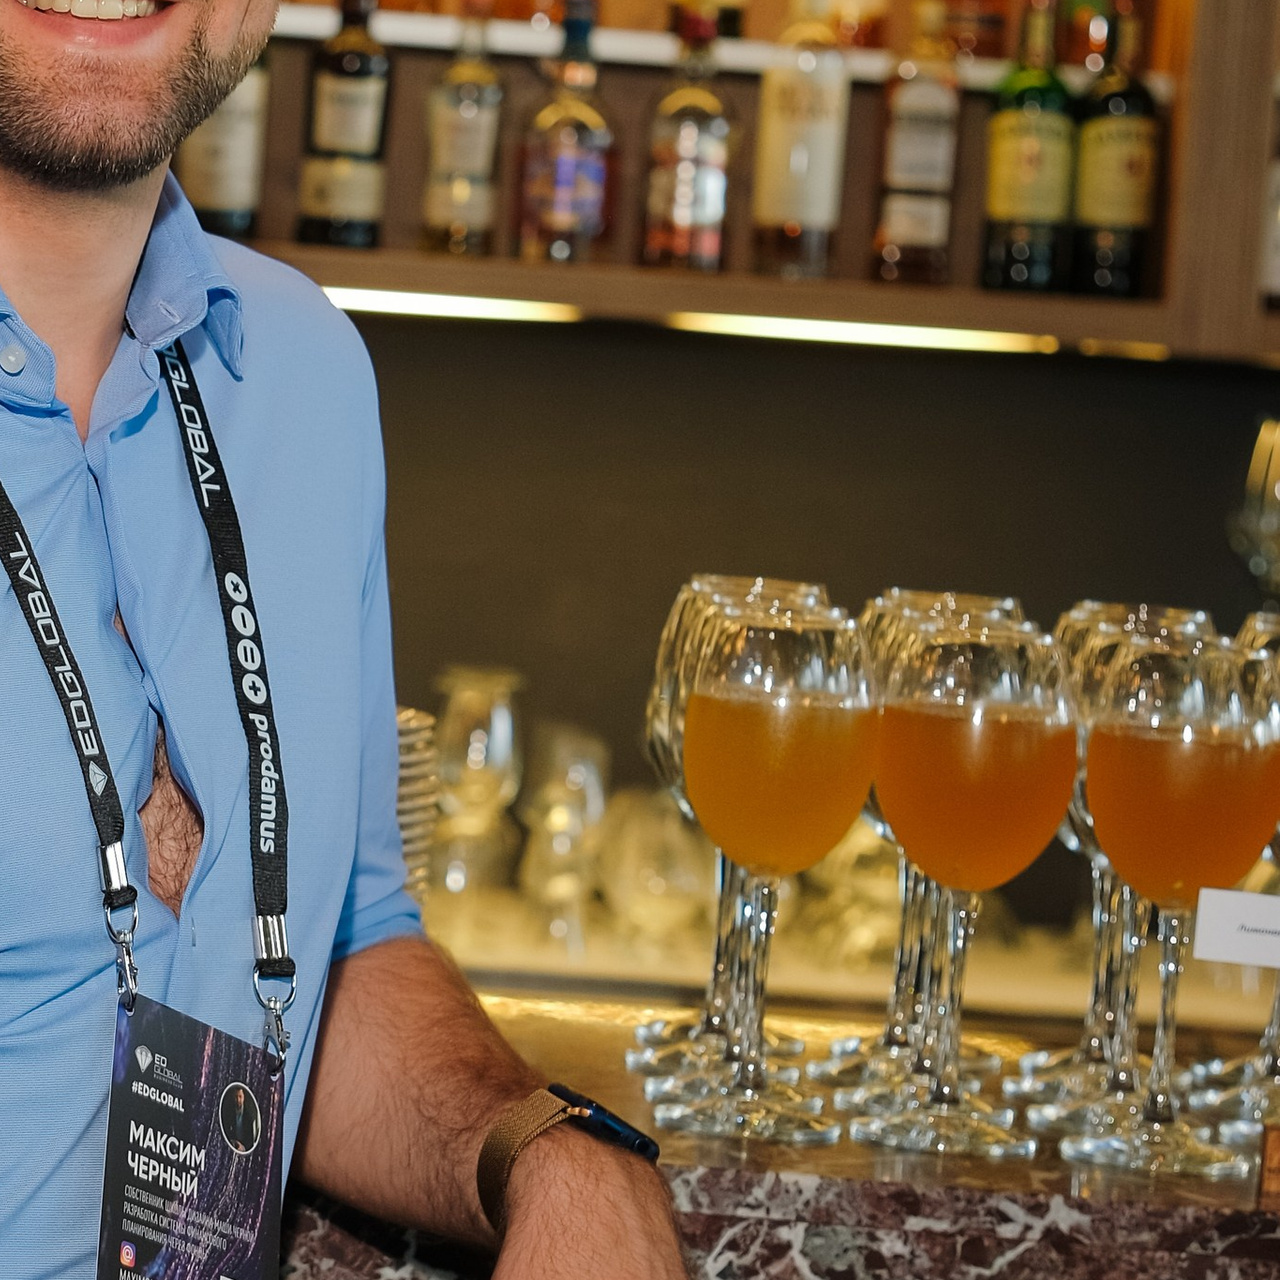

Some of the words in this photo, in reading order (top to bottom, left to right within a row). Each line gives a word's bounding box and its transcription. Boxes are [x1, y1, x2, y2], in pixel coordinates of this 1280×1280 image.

[163, 344, 221, 508] GLOBAL
[9, 531, 100, 756] EDGLOBAL
[248, 712, 280, 854] prodamus
[153, 1064, 183, 1084] GLOBAL
[154, 1053, 167, 1067] ED
[131, 1080, 185, 1112] #EDGLOBAL
[129, 1120, 206, 1171] МАКСИМ
[127, 1150, 199, 1199] ЧЕРНЫЙ
[123, 1201, 158, 1225] РАЗРАБОТКА
